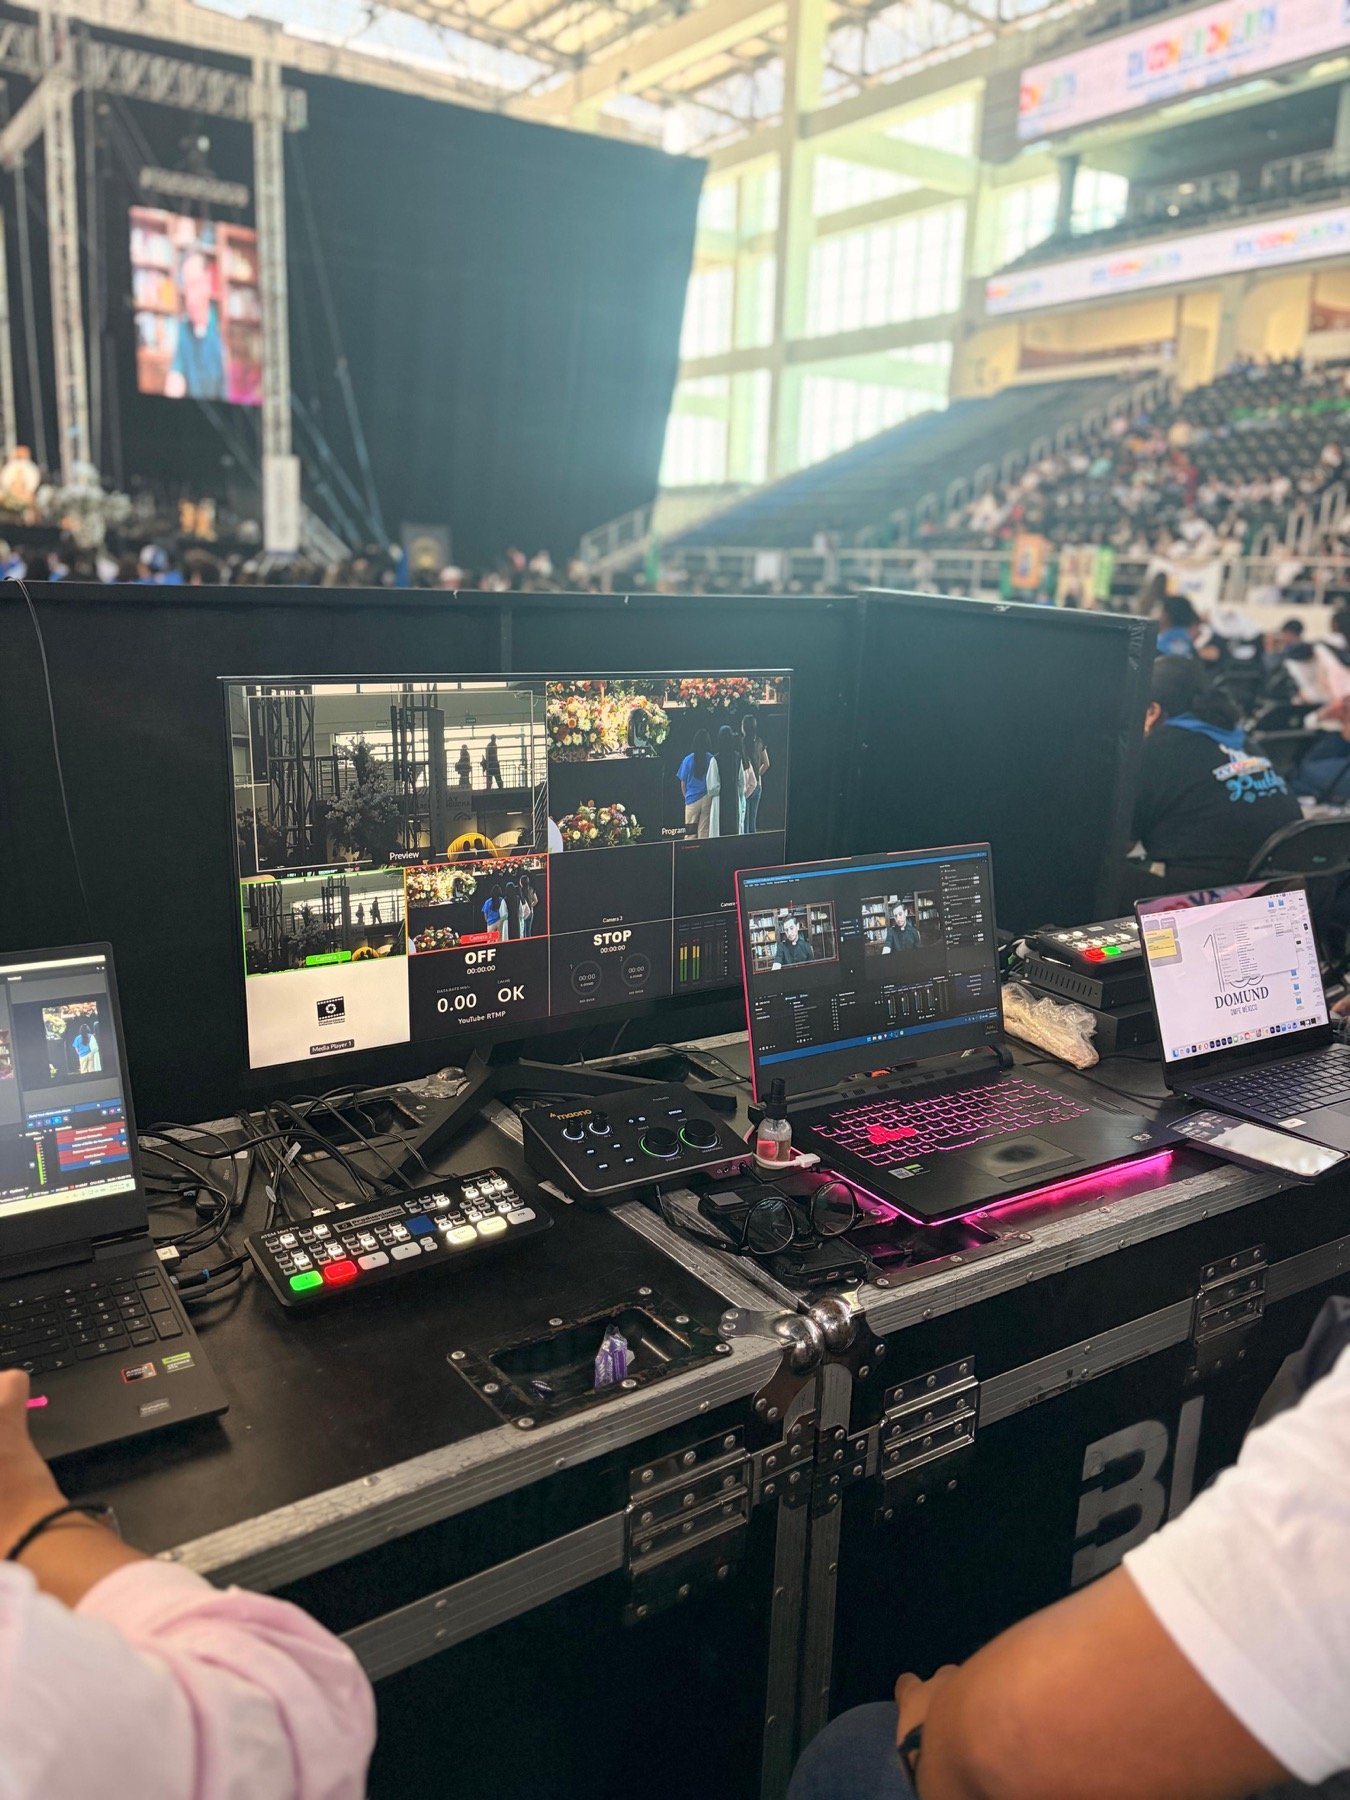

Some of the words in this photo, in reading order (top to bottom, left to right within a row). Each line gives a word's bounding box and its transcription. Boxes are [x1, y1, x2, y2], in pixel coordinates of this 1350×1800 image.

[661, 827, 686, 836] Program
[389, 851, 420, 861] Preview
[593, 930, 632, 946] STOP
[600, 944, 626, 954] 00:00:00
[464, 948, 497, 965] OFF
[466, 965, 496, 975] 00:00:00
[497, 985, 525, 1003] OK
[1214, 986, 1269, 1009] DOMUND
[437, 993, 477, 1013] 0.00
[458, 1015, 485, 1025] YouTube
[486, 1010, 506, 1020] RTMP
[311, 1044, 330, 1053] Media
[330, 1042, 348, 1051] Player
[557, 1108, 592, 1121] maono
